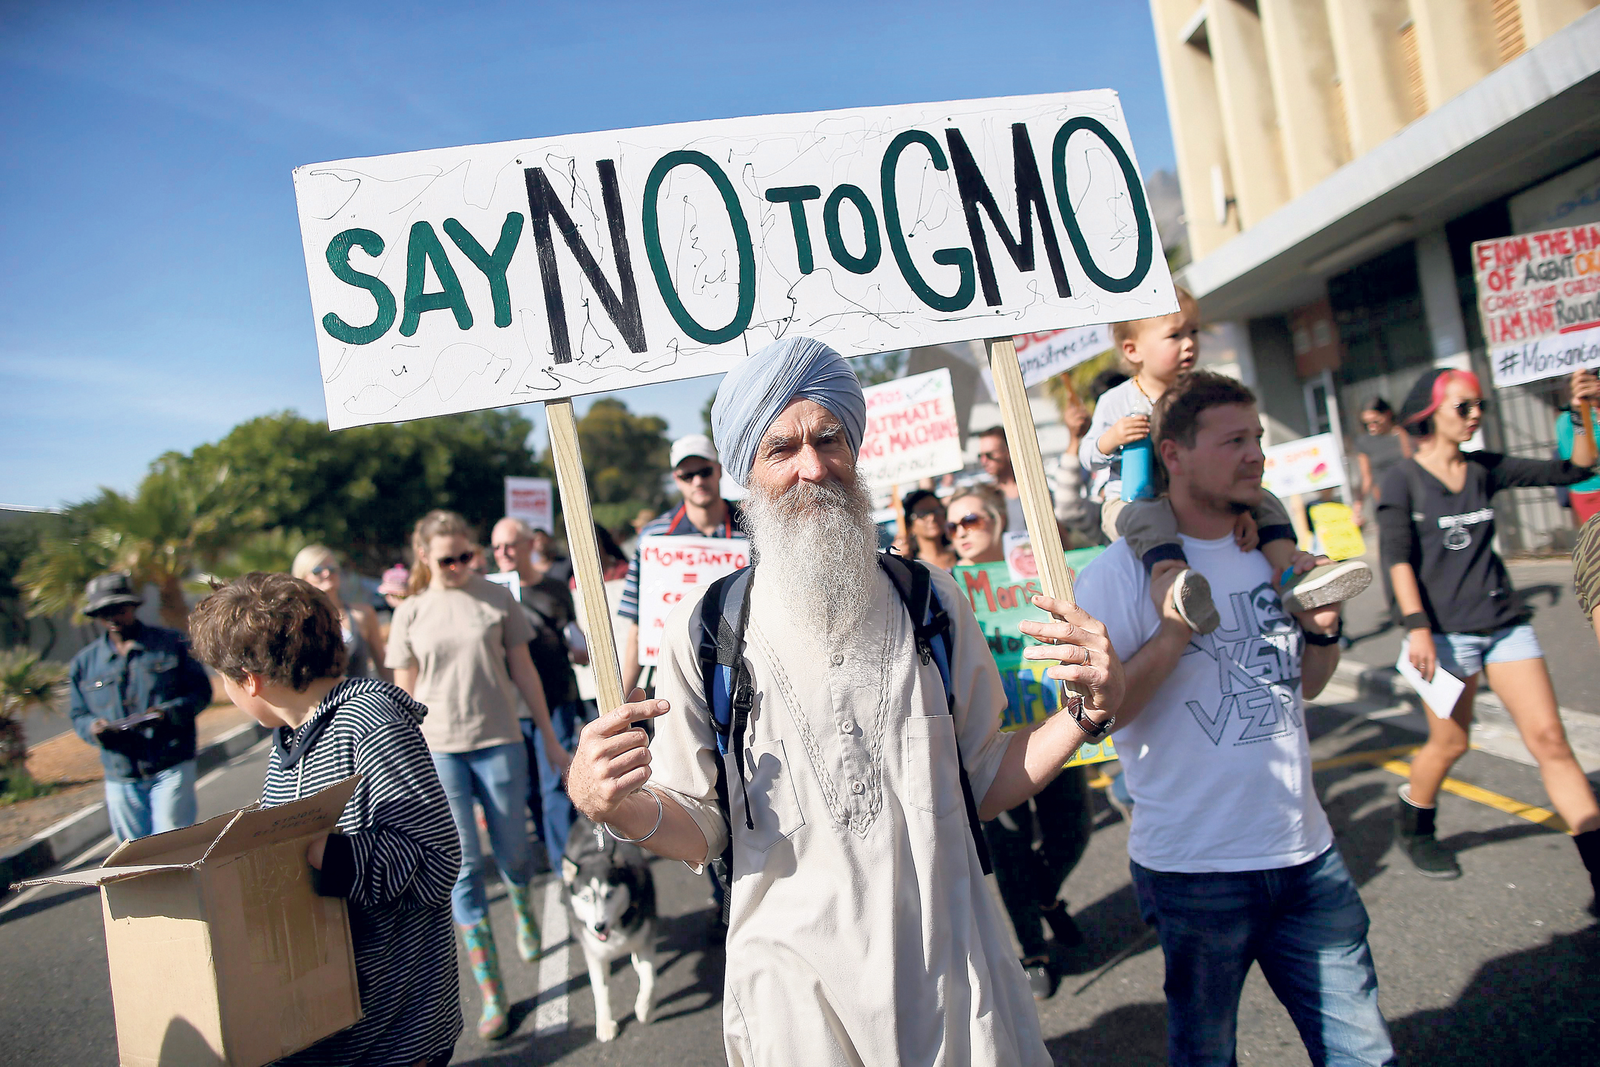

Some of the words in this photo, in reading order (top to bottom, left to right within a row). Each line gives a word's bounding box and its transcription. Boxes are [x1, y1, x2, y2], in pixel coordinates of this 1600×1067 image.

[322, 211, 524, 345] SAY
[524, 150, 756, 364] NO
[765, 183, 882, 275] TO
[881, 116, 1153, 312] GMO
[1533, 231, 1572, 257] THE
[1487, 267, 1516, 291] OF
[1524, 254, 1574, 285] AGENT
[1500, 311, 1527, 342] AM
[1527, 302, 1557, 336] NOT
[645, 547, 746, 569] MONSANTO
